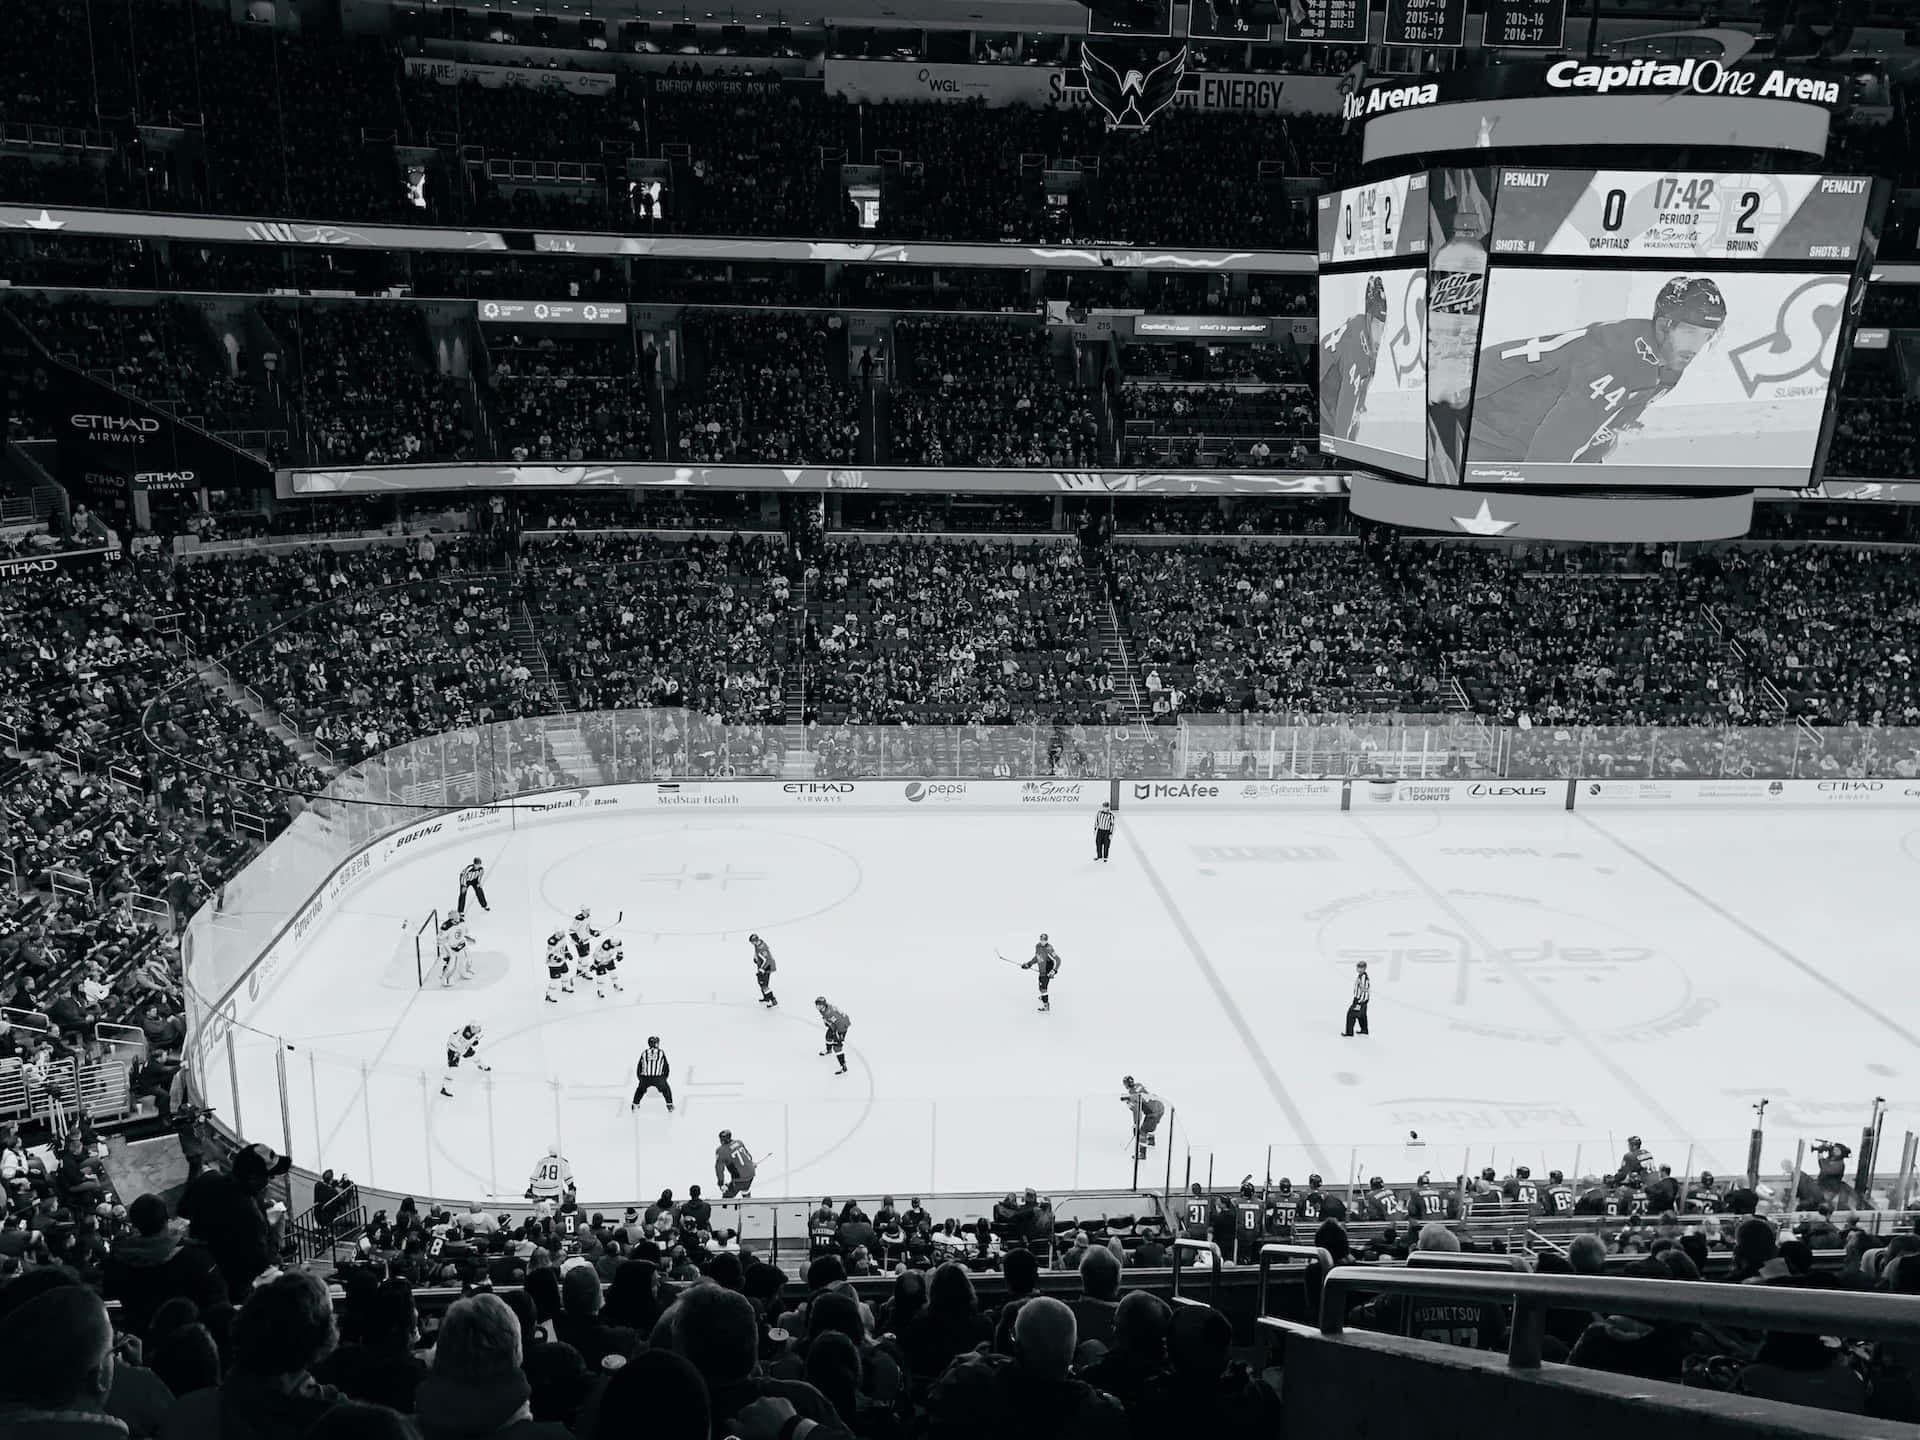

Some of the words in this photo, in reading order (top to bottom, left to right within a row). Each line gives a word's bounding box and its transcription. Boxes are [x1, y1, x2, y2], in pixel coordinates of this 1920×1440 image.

[1405, 11, 1445, 24] 2015-16
[1505, 13, 1544, 25] 2015-16
[1403, 27, 1444, 40] 2016-17
[1504, 28, 1543, 41] 2016-17
[411, 62, 428, 79] WE
[656, 79, 692, 94] ENERGY
[747, 81, 764, 95] ASK
[767, 82, 781, 94] US
[929, 80, 960, 93] WGL
[1202, 79, 1283, 108] ENERGY
[1759, 70, 1839, 103] Arena
[1366, 83, 1439, 111] Arena
[1504, 173, 1549, 187] PENALTY
[1821, 179, 1866, 194] PENALTY
[1654, 178, 1714, 210] 17:42
[1384, 196, 1392, 235] 2
[1602, 189, 1626, 232] 0
[1735, 192, 1760, 234] 2
[1345, 204, 1352, 241] 0
[1660, 213, 1691, 224] PERIOD
[1692, 213, 1700, 224] 2
[1495, 239, 1528, 252] SHOTS:
[1589, 237, 1630, 250] CAPITALS
[1725, 239, 1759, 252] BRUINS
[1808, 245, 1839, 257] SHOTS:
[1096, 321, 1111, 330] 215
[1293, 324, 1308, 333] 215
[1589, 373, 1626, 412] 44
[70, 414, 160, 432] ETIHAD
[88, 432, 146, 444] AIRWAYS
[134, 471, 195, 483] ETIHAD
[768, 535, 782, 547] 112
[103, 551, 122, 561] 115
[783, 782, 855, 793] ETIHAD
[928, 783, 968, 797] pepsi
[1154, 783, 1219, 798] McAfee
[1488, 786, 1546, 796] LEXUS
[1817, 781, 1883, 791] ETIHAD
[658, 795, 703, 805] MedStar
[705, 795, 740, 805] Health
[1022, 795, 1080, 803] WASHINGTON
[1412, 793, 1450, 801] DONUTS
[396, 823, 443, 848] BOEING
[731, 1146, 752, 1166] 77
[539, 1164, 558, 1180] 48
[1518, 1187, 1537, 1204] 43
[1423, 1196, 1441, 1214] 10
[1189, 1205, 1205, 1224] 31
[1244, 1210, 1256, 1230] 8
[1277, 1209, 1296, 1226] 39
[564, 1216, 575, 1234] 8
[429, 1238, 444, 1257] 8
